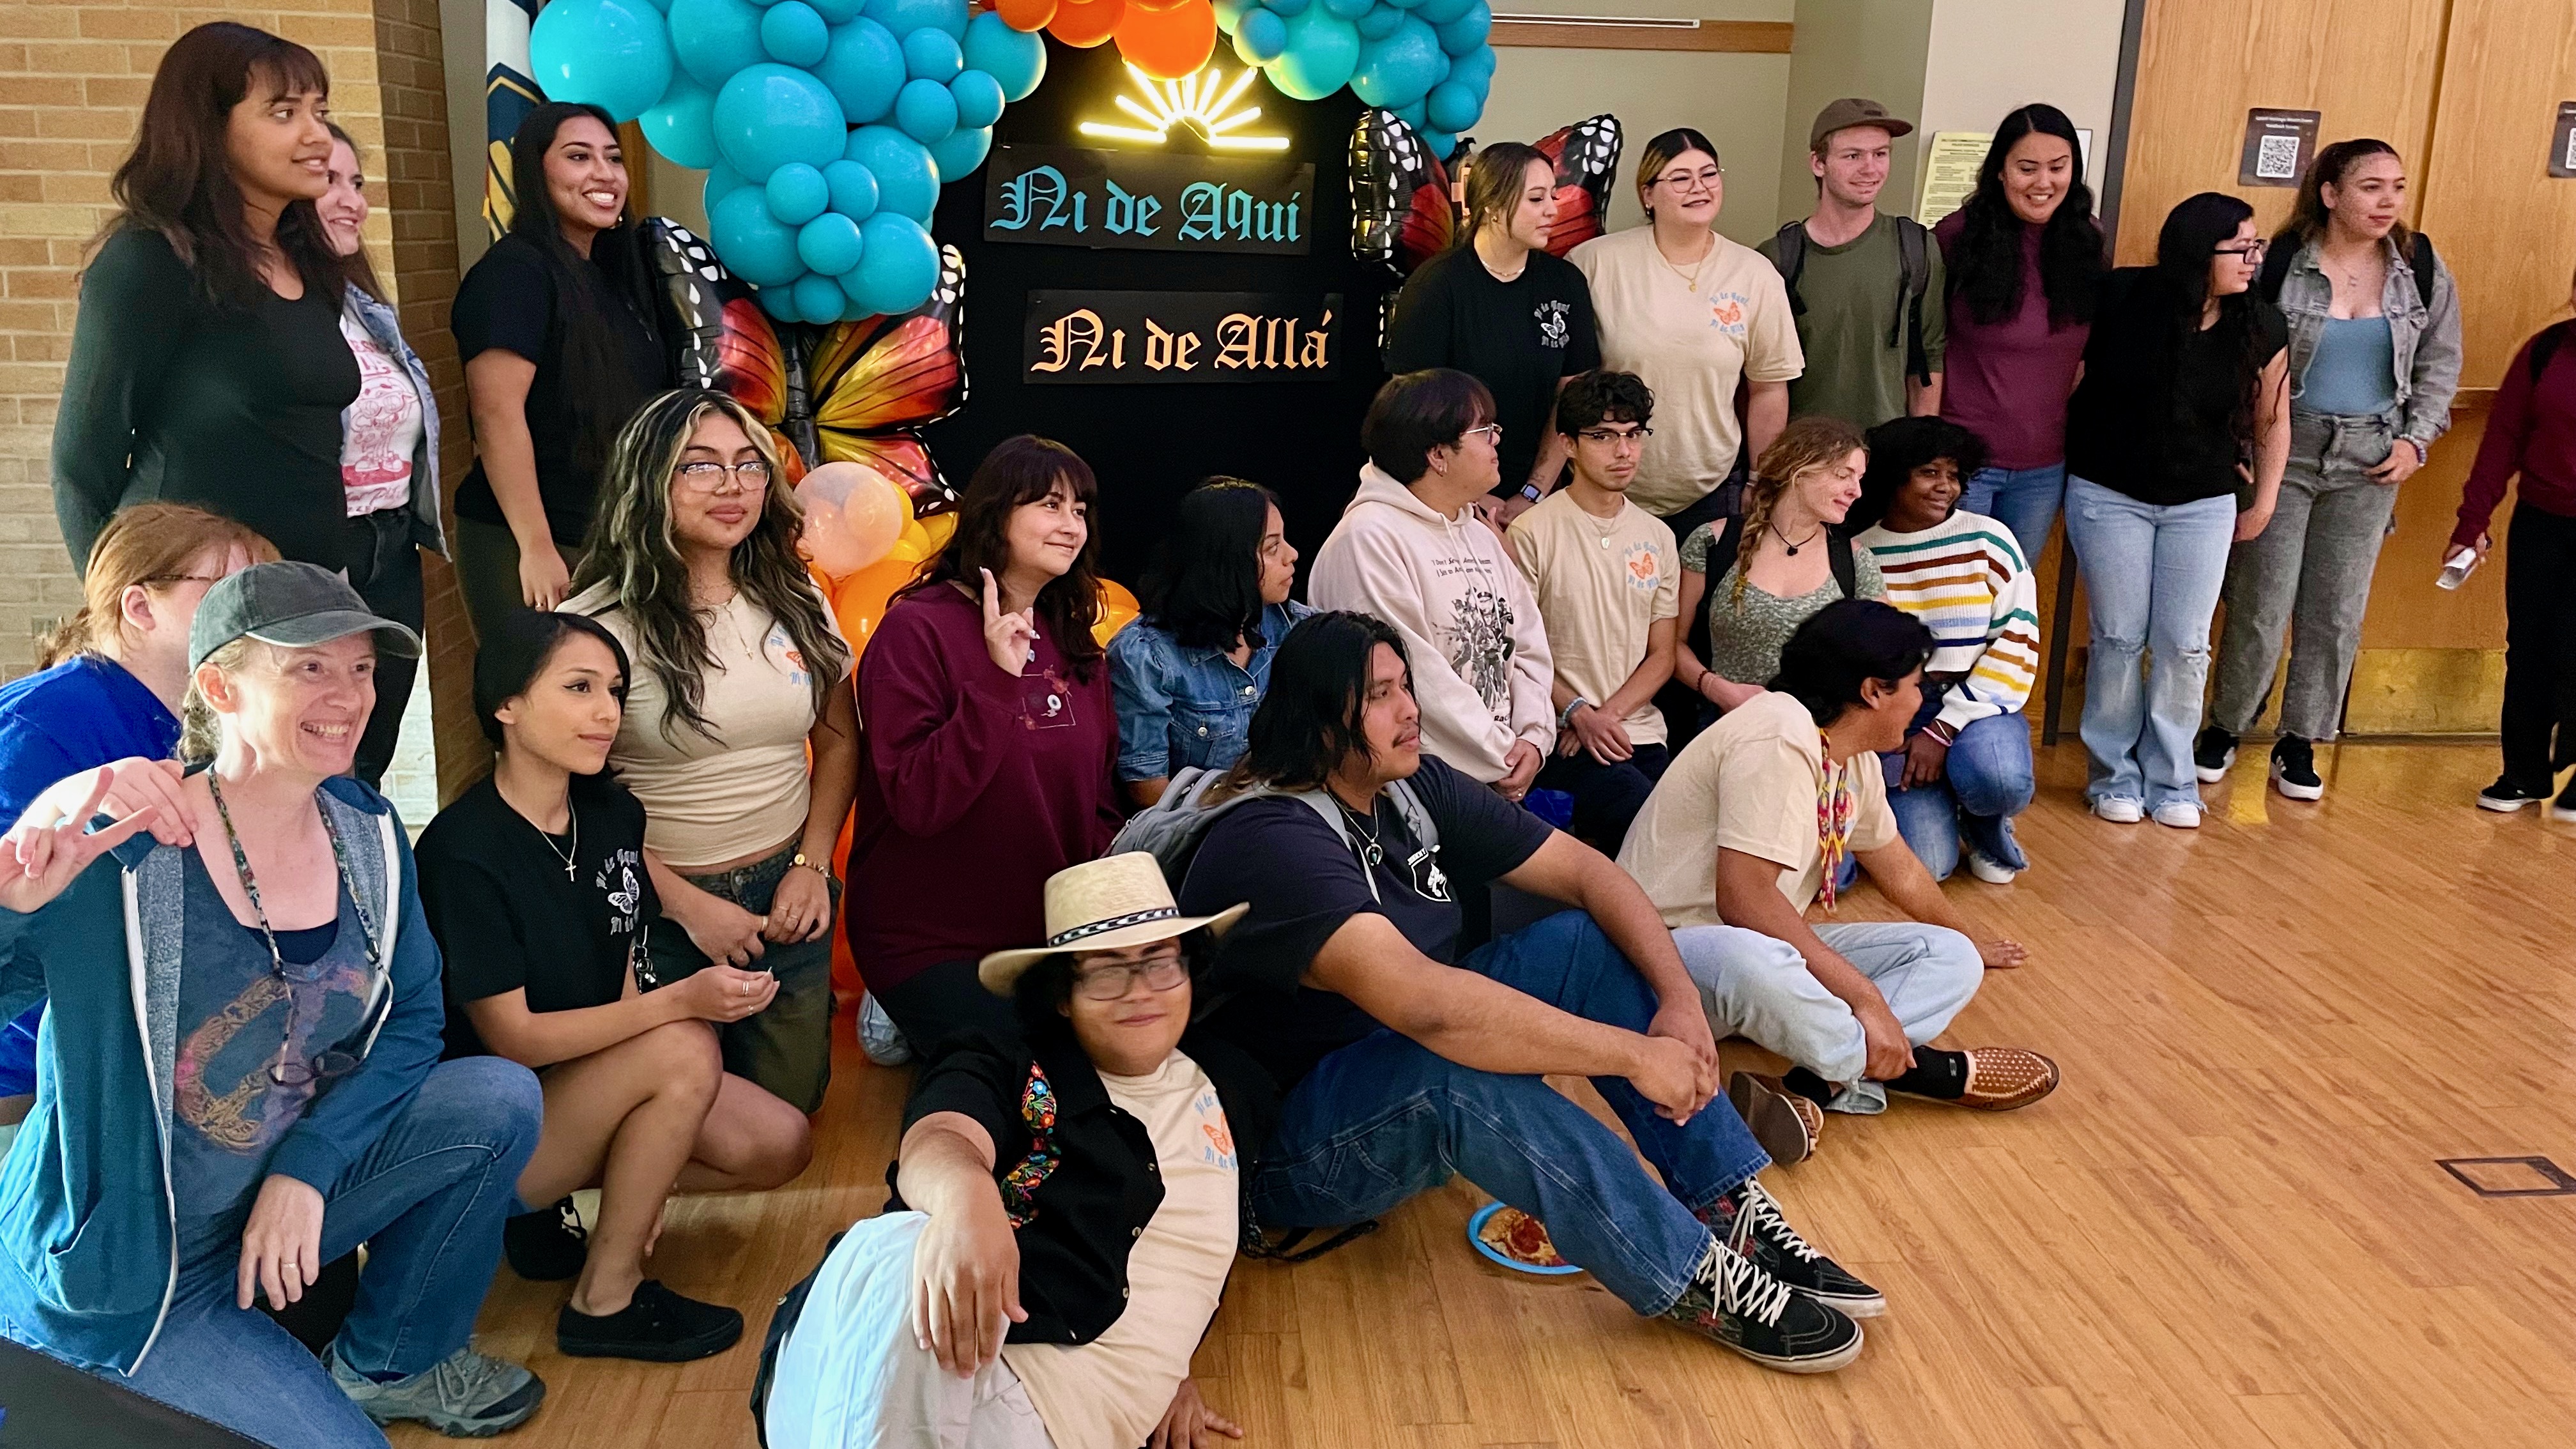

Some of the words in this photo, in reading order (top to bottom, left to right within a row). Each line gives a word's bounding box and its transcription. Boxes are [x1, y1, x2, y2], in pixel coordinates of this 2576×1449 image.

[990, 165, 1089, 234] Ni
[1104, 178, 1162, 237] de
[1177, 181, 1301, 243] Aquí
[1030, 309, 1126, 372] Ni
[1144, 318, 1201, 371] de
[1214, 309, 1333, 371] Allá
